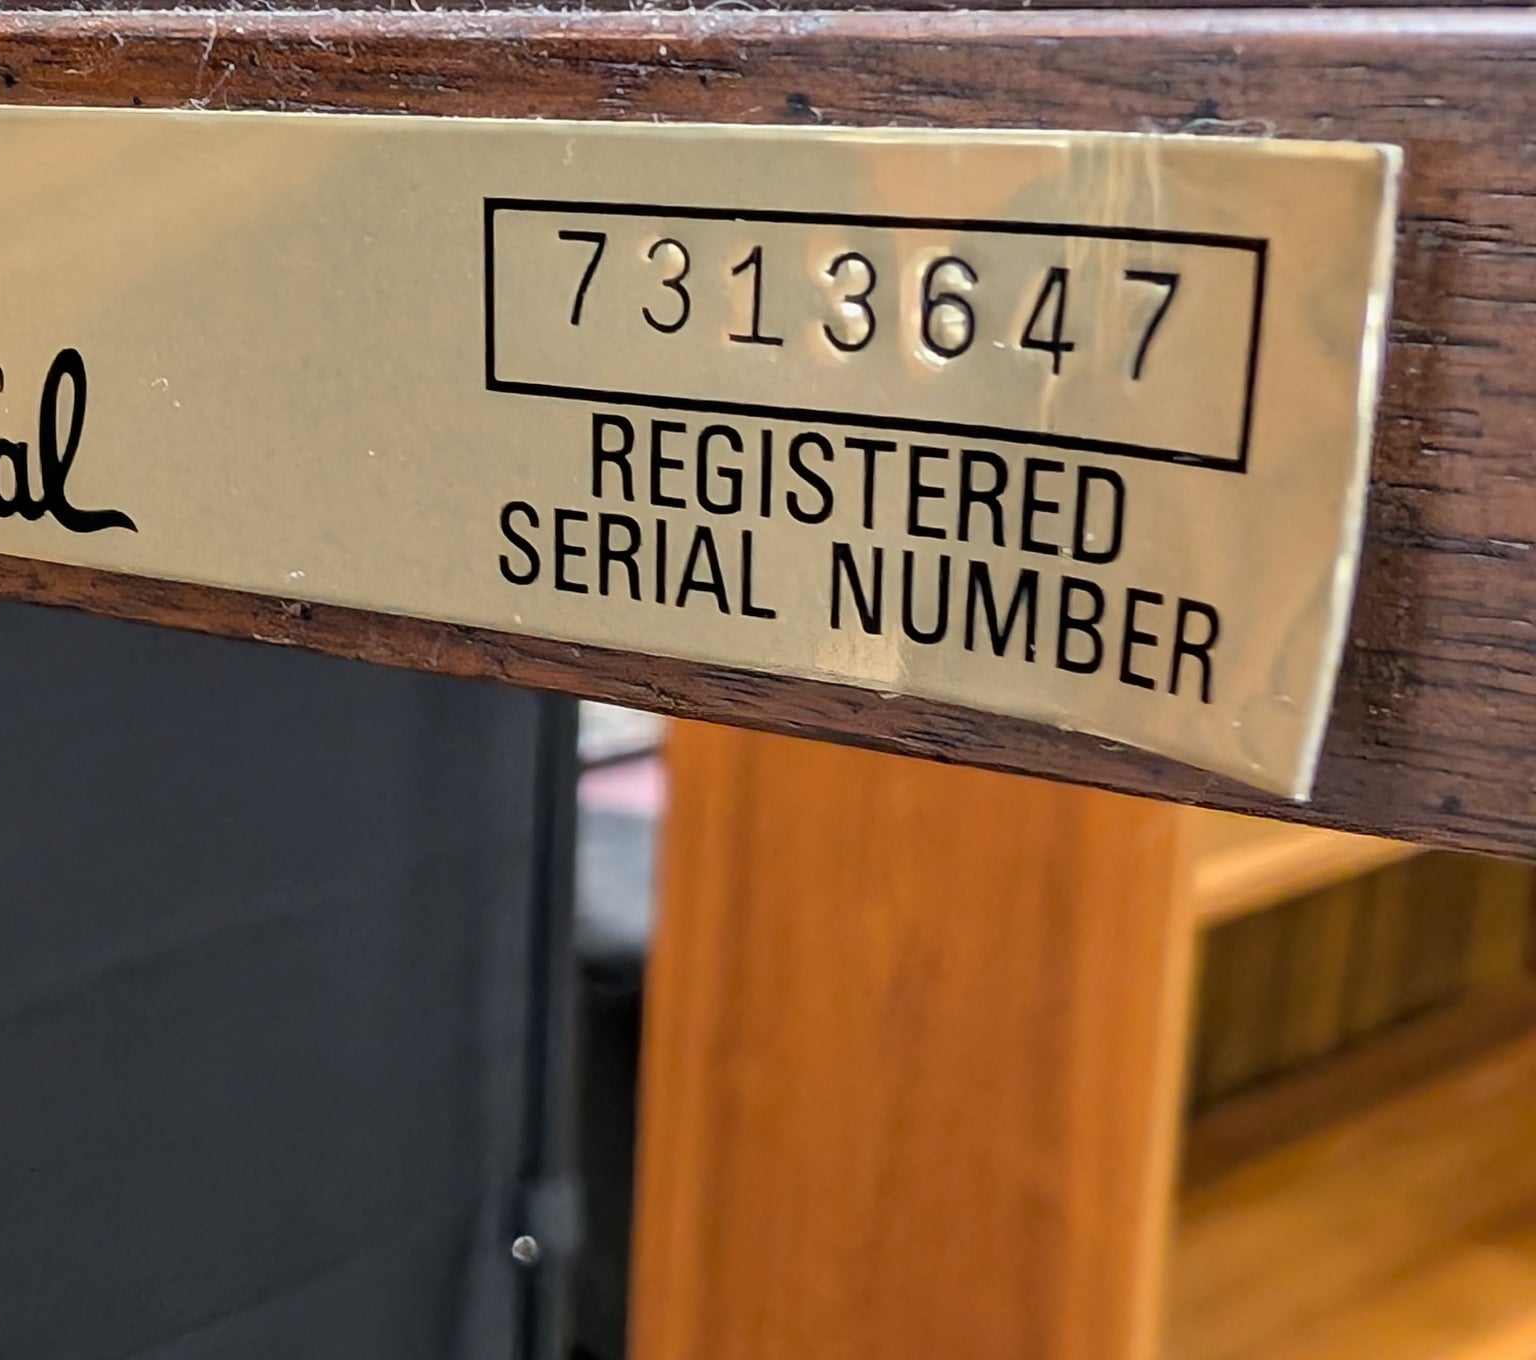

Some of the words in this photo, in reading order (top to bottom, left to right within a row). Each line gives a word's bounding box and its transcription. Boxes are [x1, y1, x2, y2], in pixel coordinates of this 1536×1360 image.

[557, 229, 1182, 382] 7313647
[591, 412, 1126, 564] REGISTERED
[498, 500, 777, 619] SERIAL
[830, 541, 1220, 704] NUMBER
